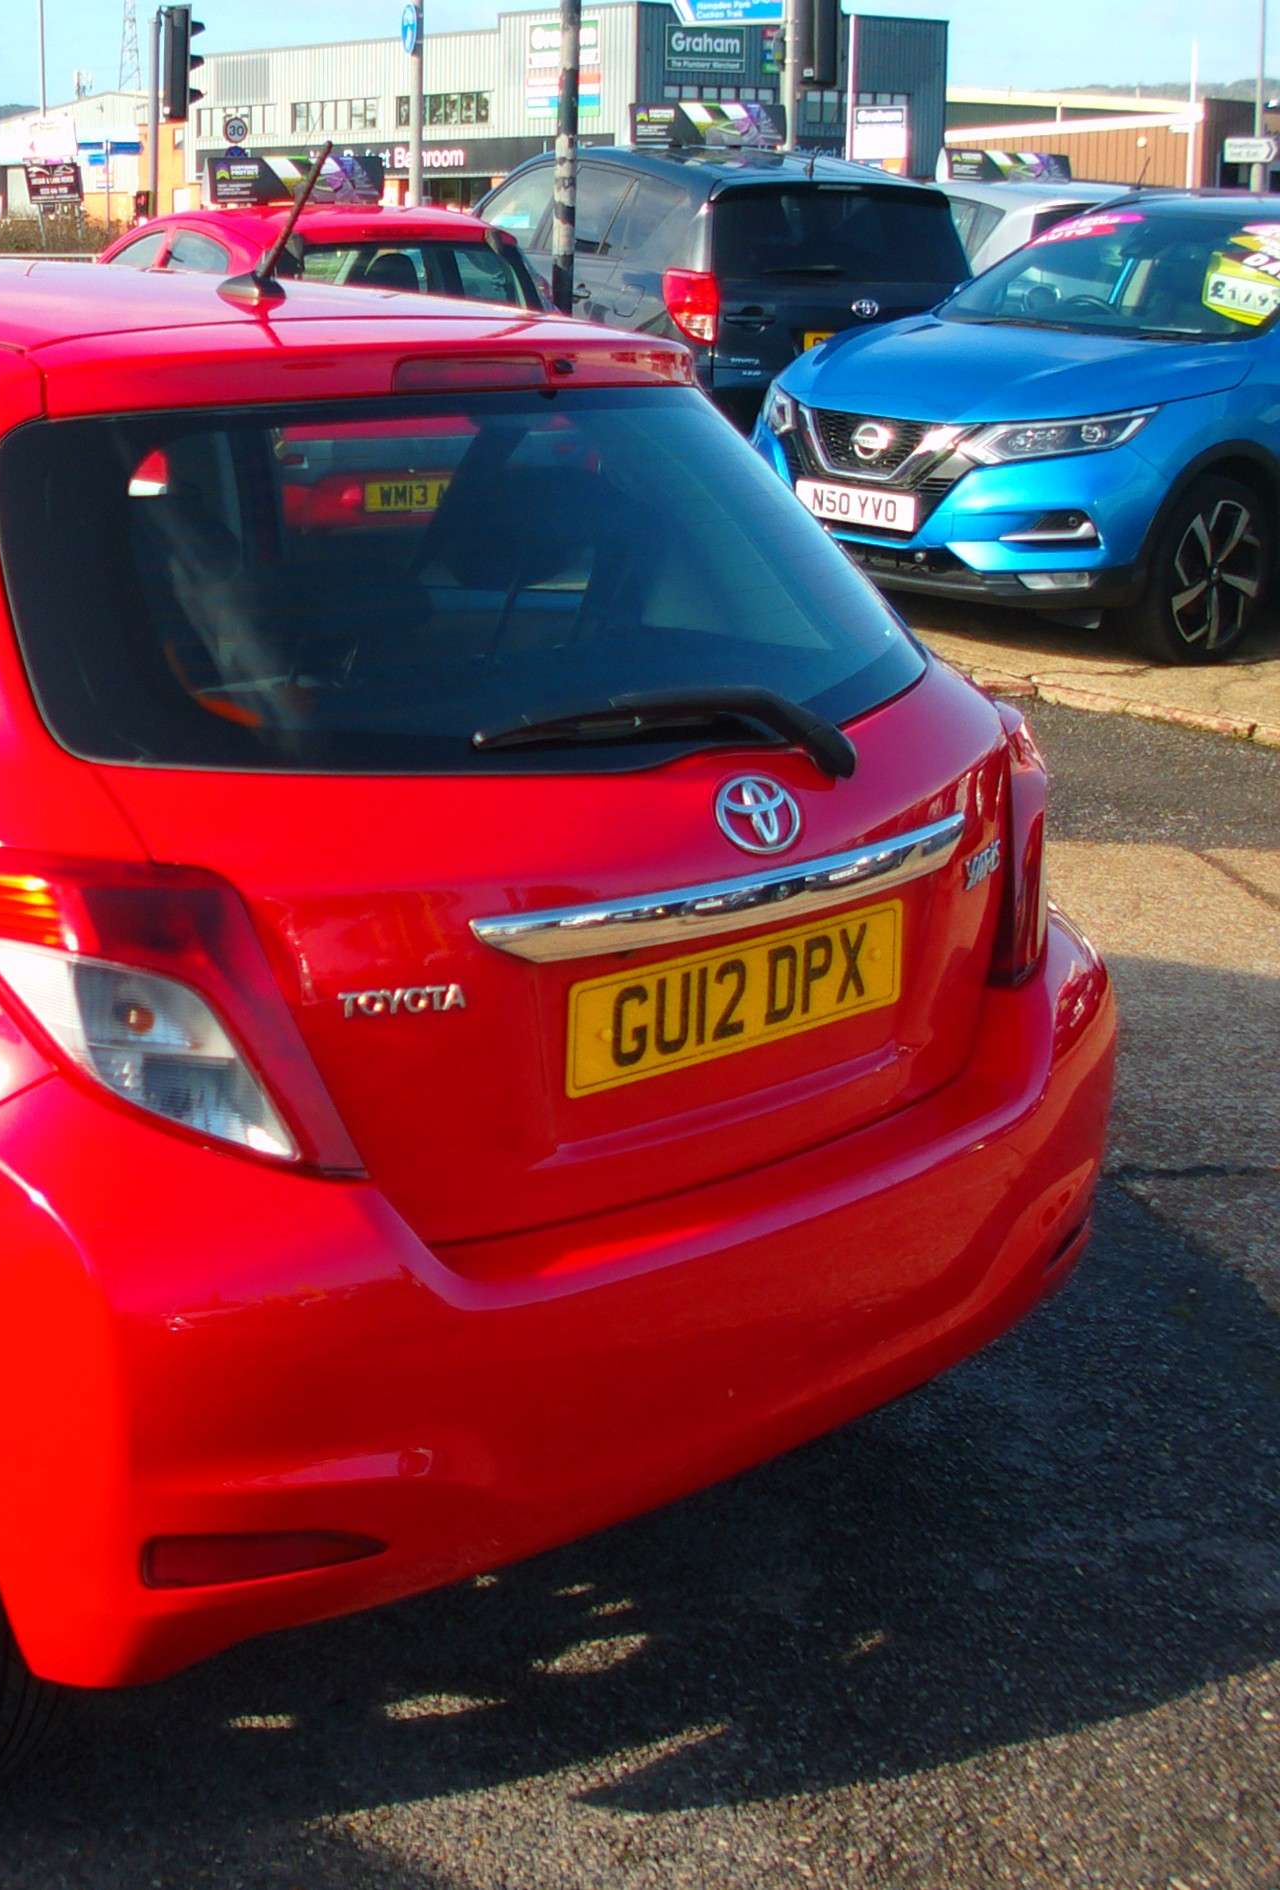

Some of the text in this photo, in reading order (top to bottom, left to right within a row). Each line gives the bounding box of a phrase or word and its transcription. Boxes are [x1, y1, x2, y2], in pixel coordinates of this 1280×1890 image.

[670, 31, 740, 54] Graham
[228, 125, 244, 138] 30
[379, 484, 428, 507] WM13
[337, 983, 467, 1018] TOYOTA
[610, 922, 868, 1067] GU12 DPX
